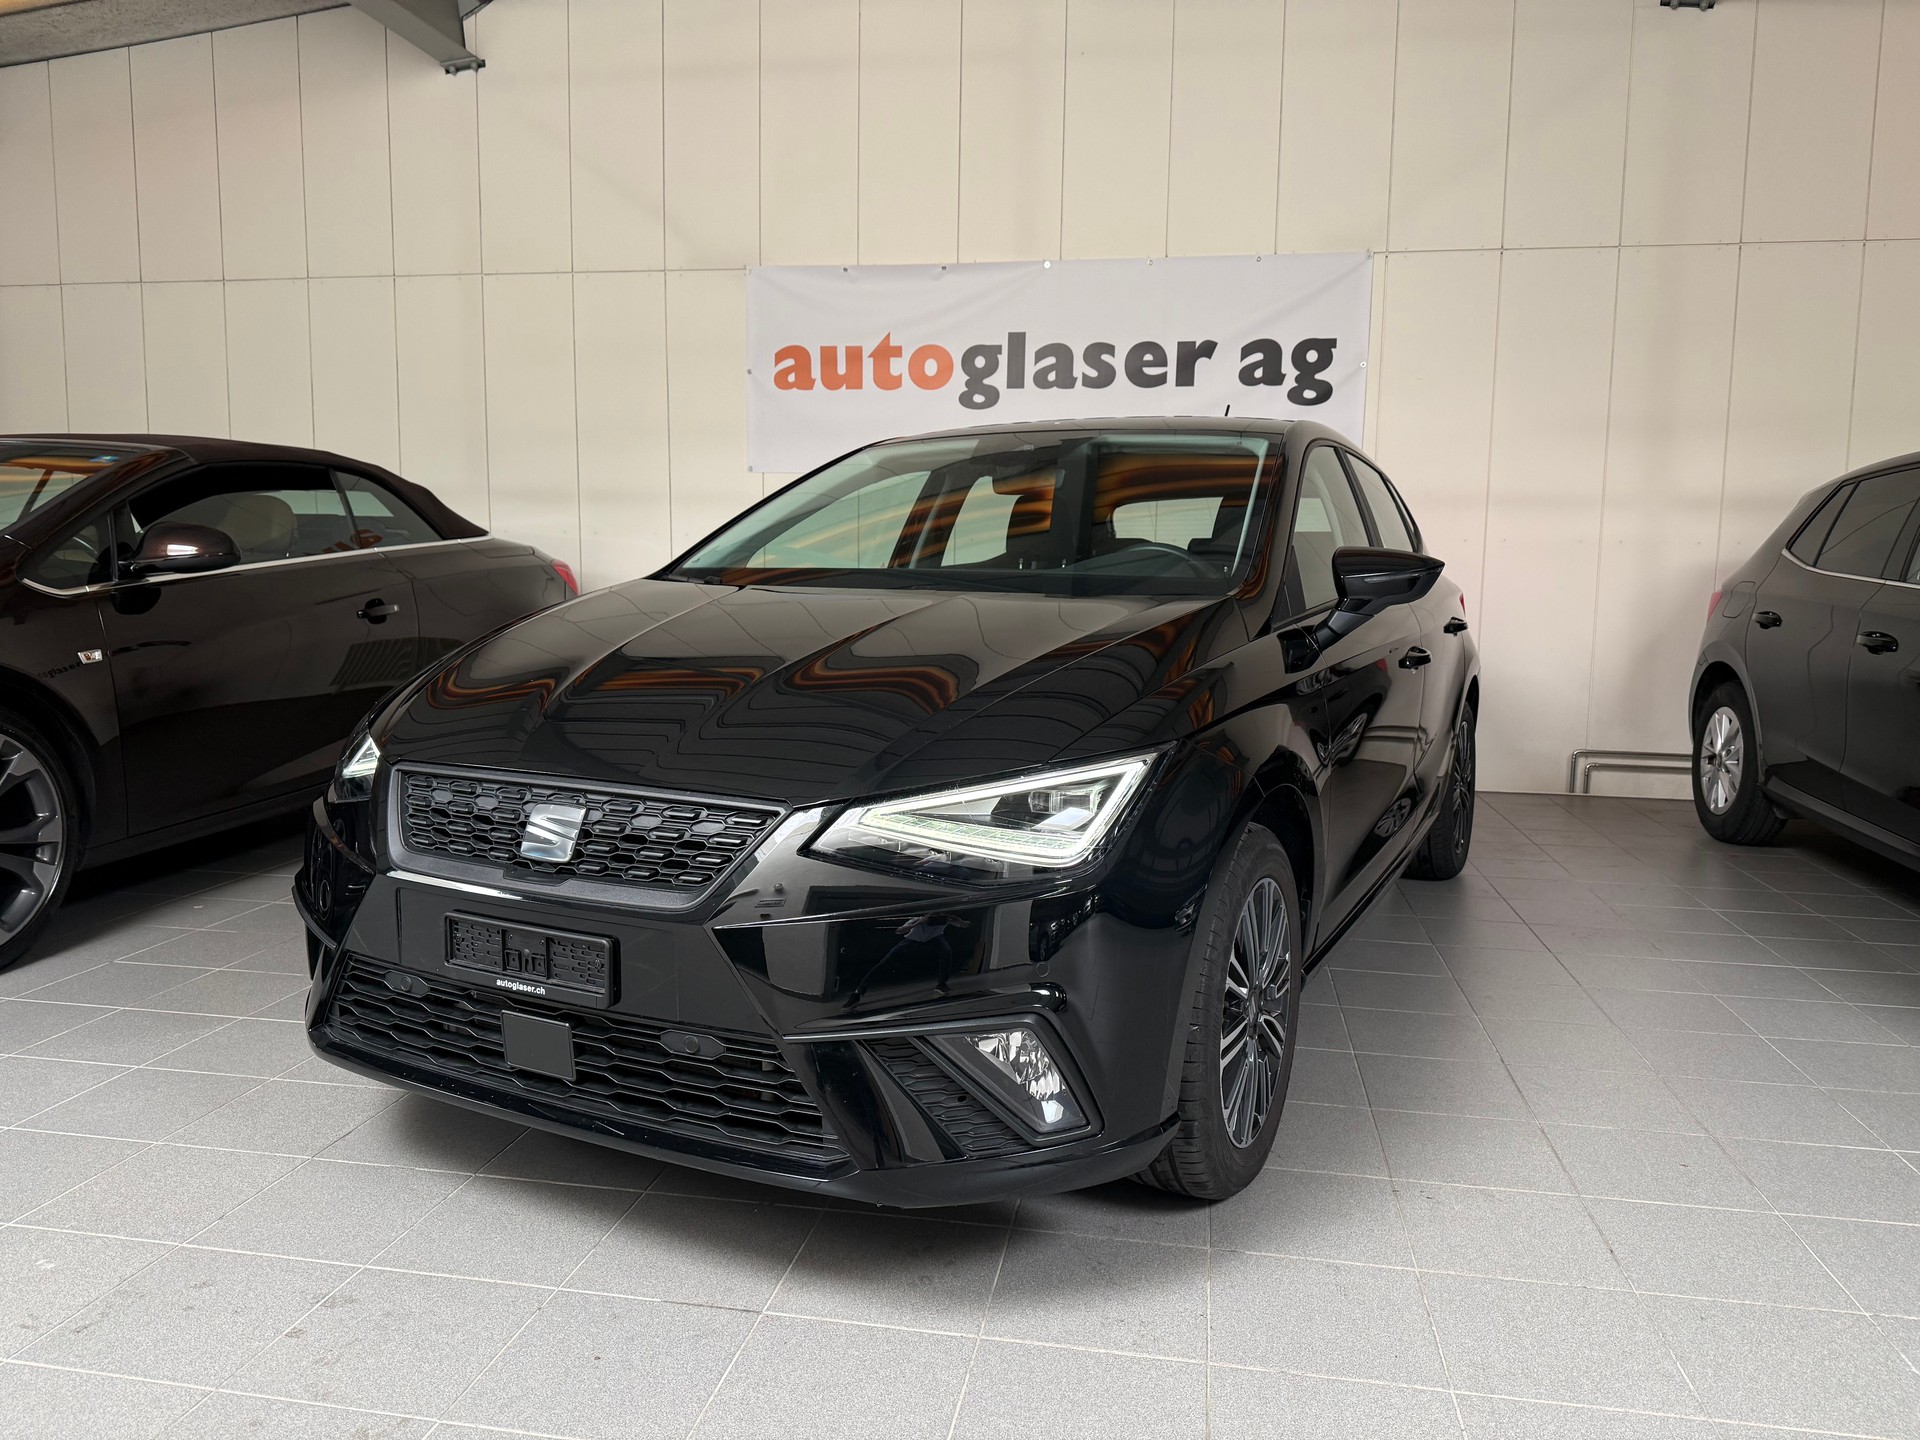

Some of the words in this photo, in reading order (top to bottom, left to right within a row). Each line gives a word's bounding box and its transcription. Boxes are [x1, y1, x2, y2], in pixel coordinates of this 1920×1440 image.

[773, 331, 1218, 410] autoglaser
[1238, 337, 1337, 406] ag
[496, 979, 545, 995] autoglaser.ch
